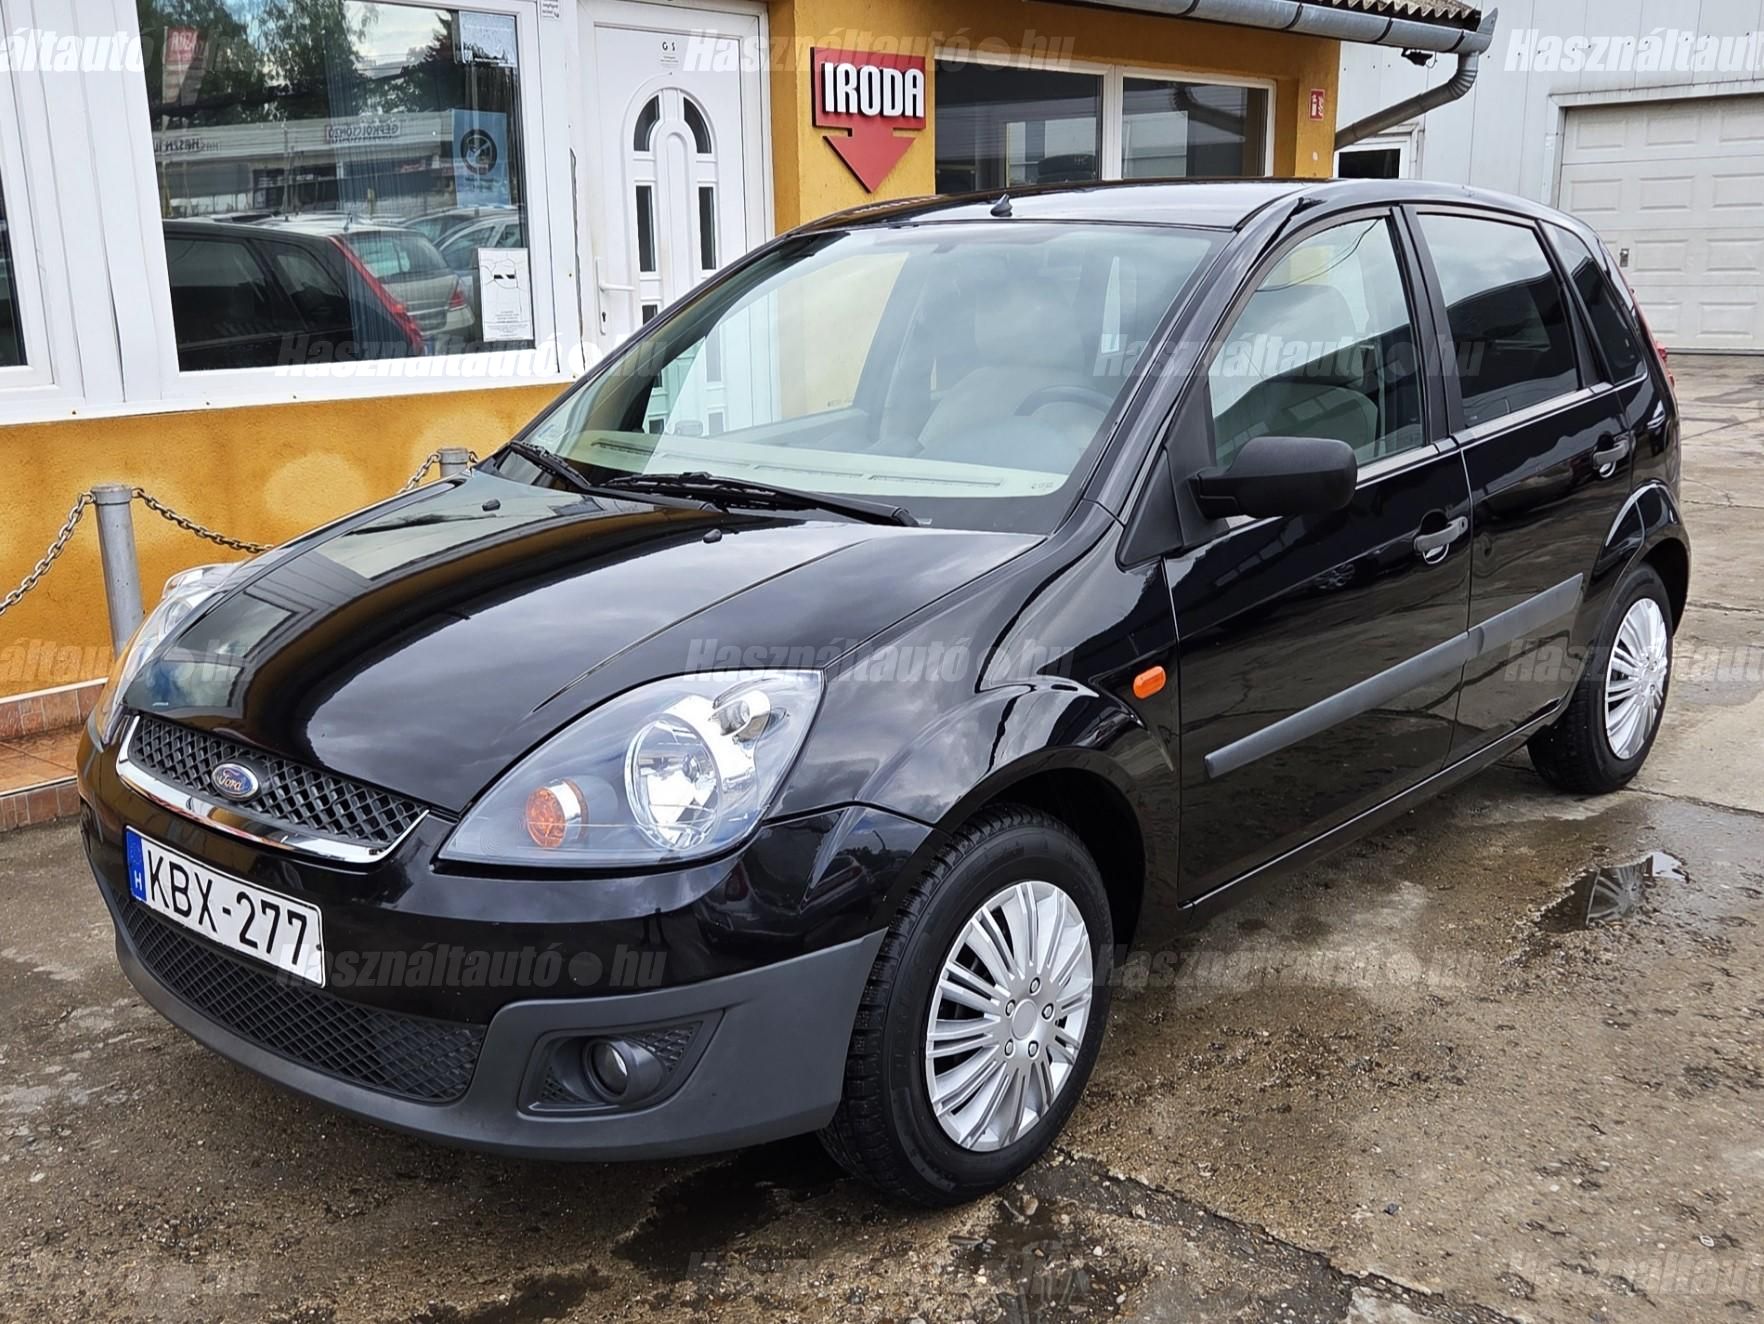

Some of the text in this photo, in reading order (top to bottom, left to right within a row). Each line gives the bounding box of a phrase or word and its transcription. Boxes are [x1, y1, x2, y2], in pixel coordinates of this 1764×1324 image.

[822, 62, 925, 118] IRODA
[218, 768, 246, 791] Ford
[133, 869, 143, 891] H
[147, 848, 308, 966] KBX-277
